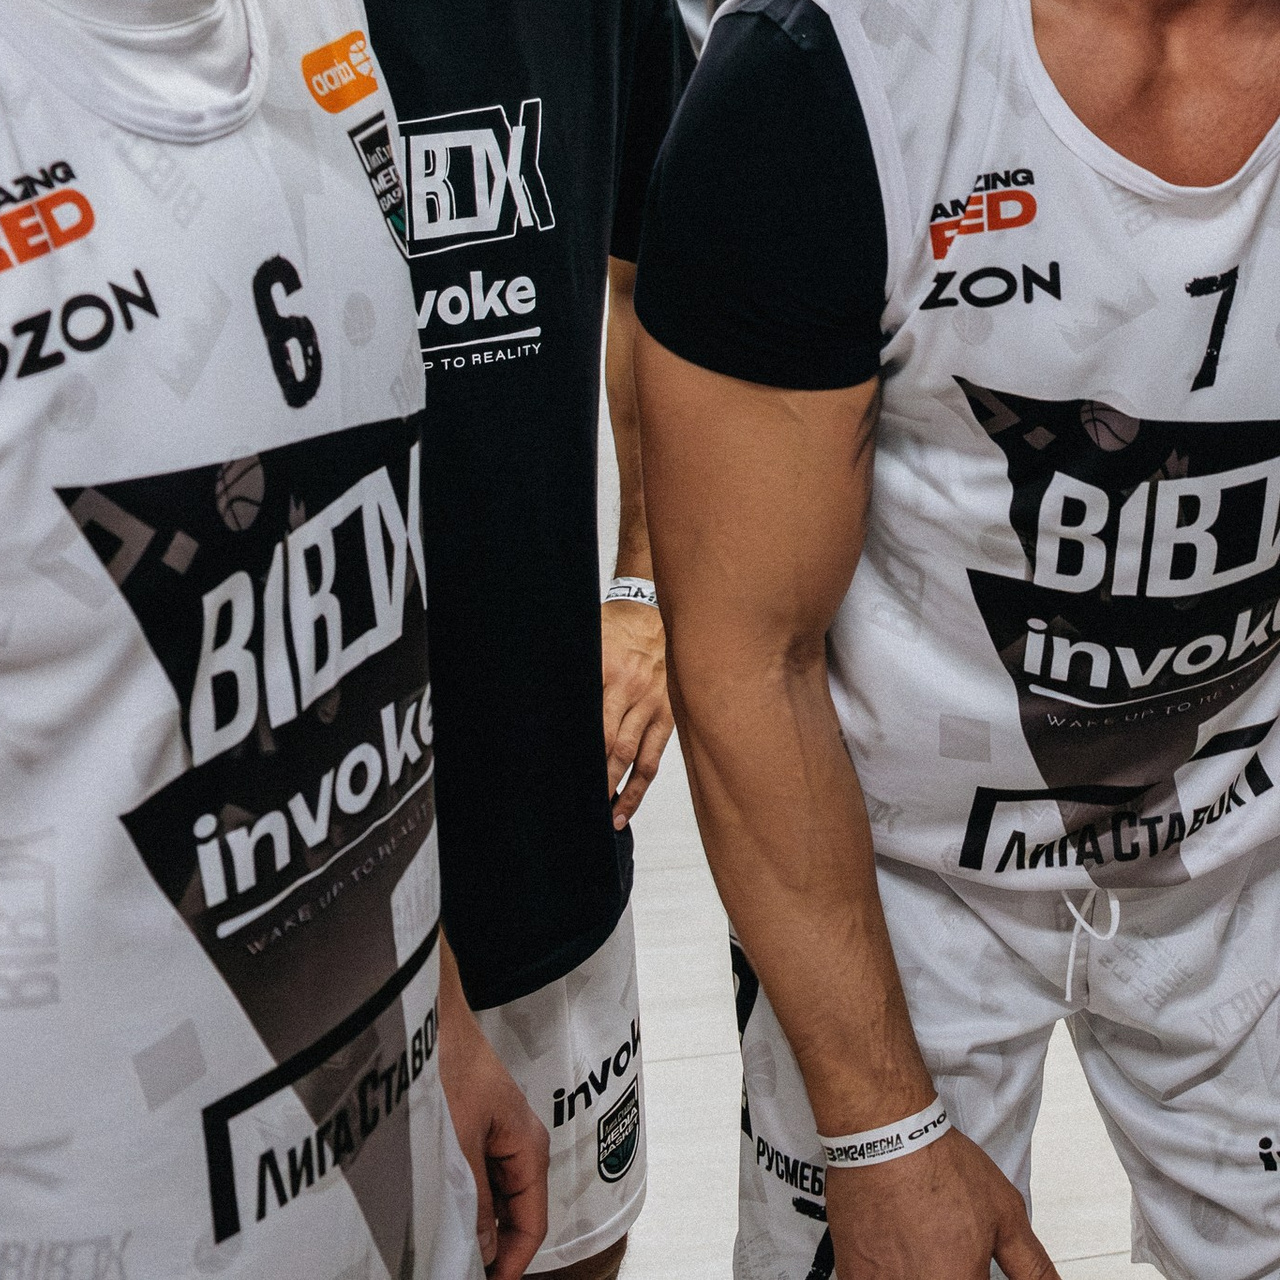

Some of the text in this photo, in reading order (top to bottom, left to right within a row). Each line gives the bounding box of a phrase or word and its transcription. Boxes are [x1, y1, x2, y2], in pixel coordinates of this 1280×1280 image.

[0, 188, 95, 275] ED
[0, 268, 159, 384] ZON
[252, 254, 322, 409] 6
[416, 271, 537, 330] voke
[919, 261, 1061, 310] ZON
[1185, 266, 1239, 393] 7
[440, 356, 466, 370] TO
[471, 343, 541, 366] REALITY
[358, 996, 439, 1142] СТАВО
[553, 1016, 641, 1129] invok
[756, 1135, 827, 1196] РУСМЕБ
